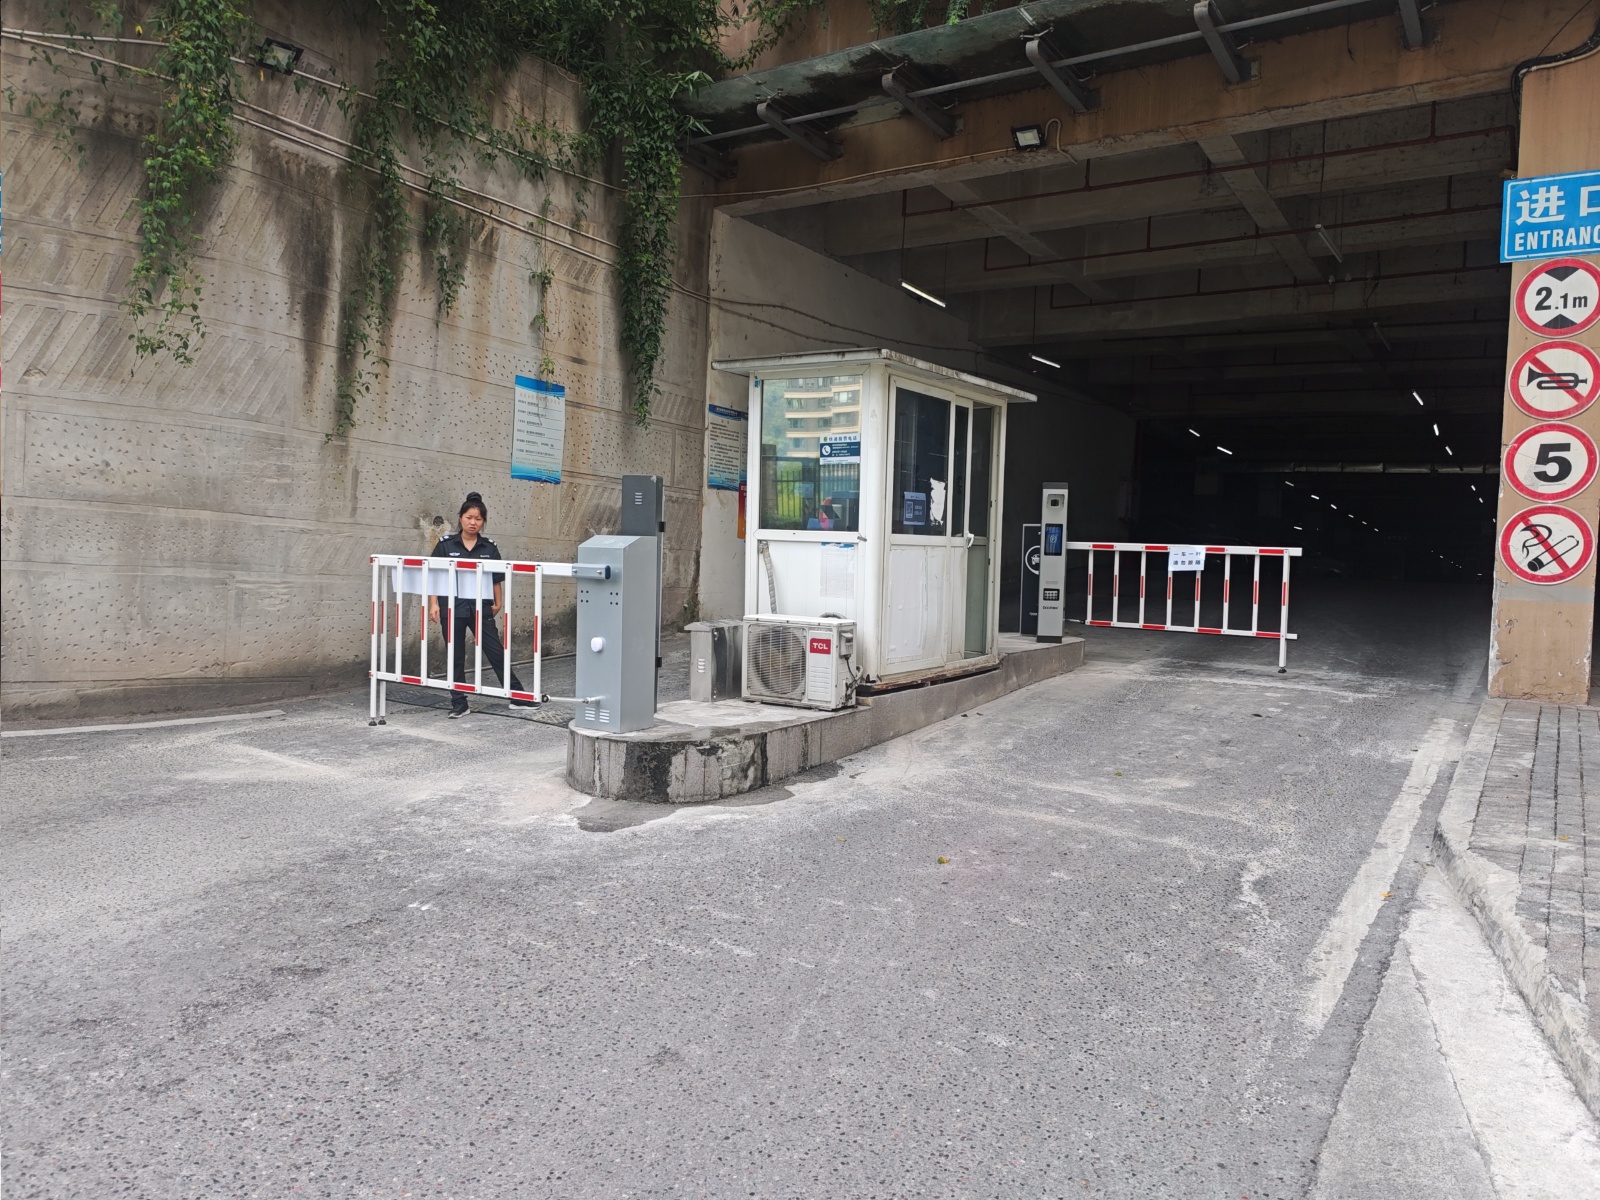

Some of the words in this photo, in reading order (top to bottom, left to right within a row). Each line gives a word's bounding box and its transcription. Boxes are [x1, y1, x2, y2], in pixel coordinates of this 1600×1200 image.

[1534, 286, 1588, 311] 2.1m
[1533, 442, 1572, 483] 5
[812, 642, 828, 650] TCL
